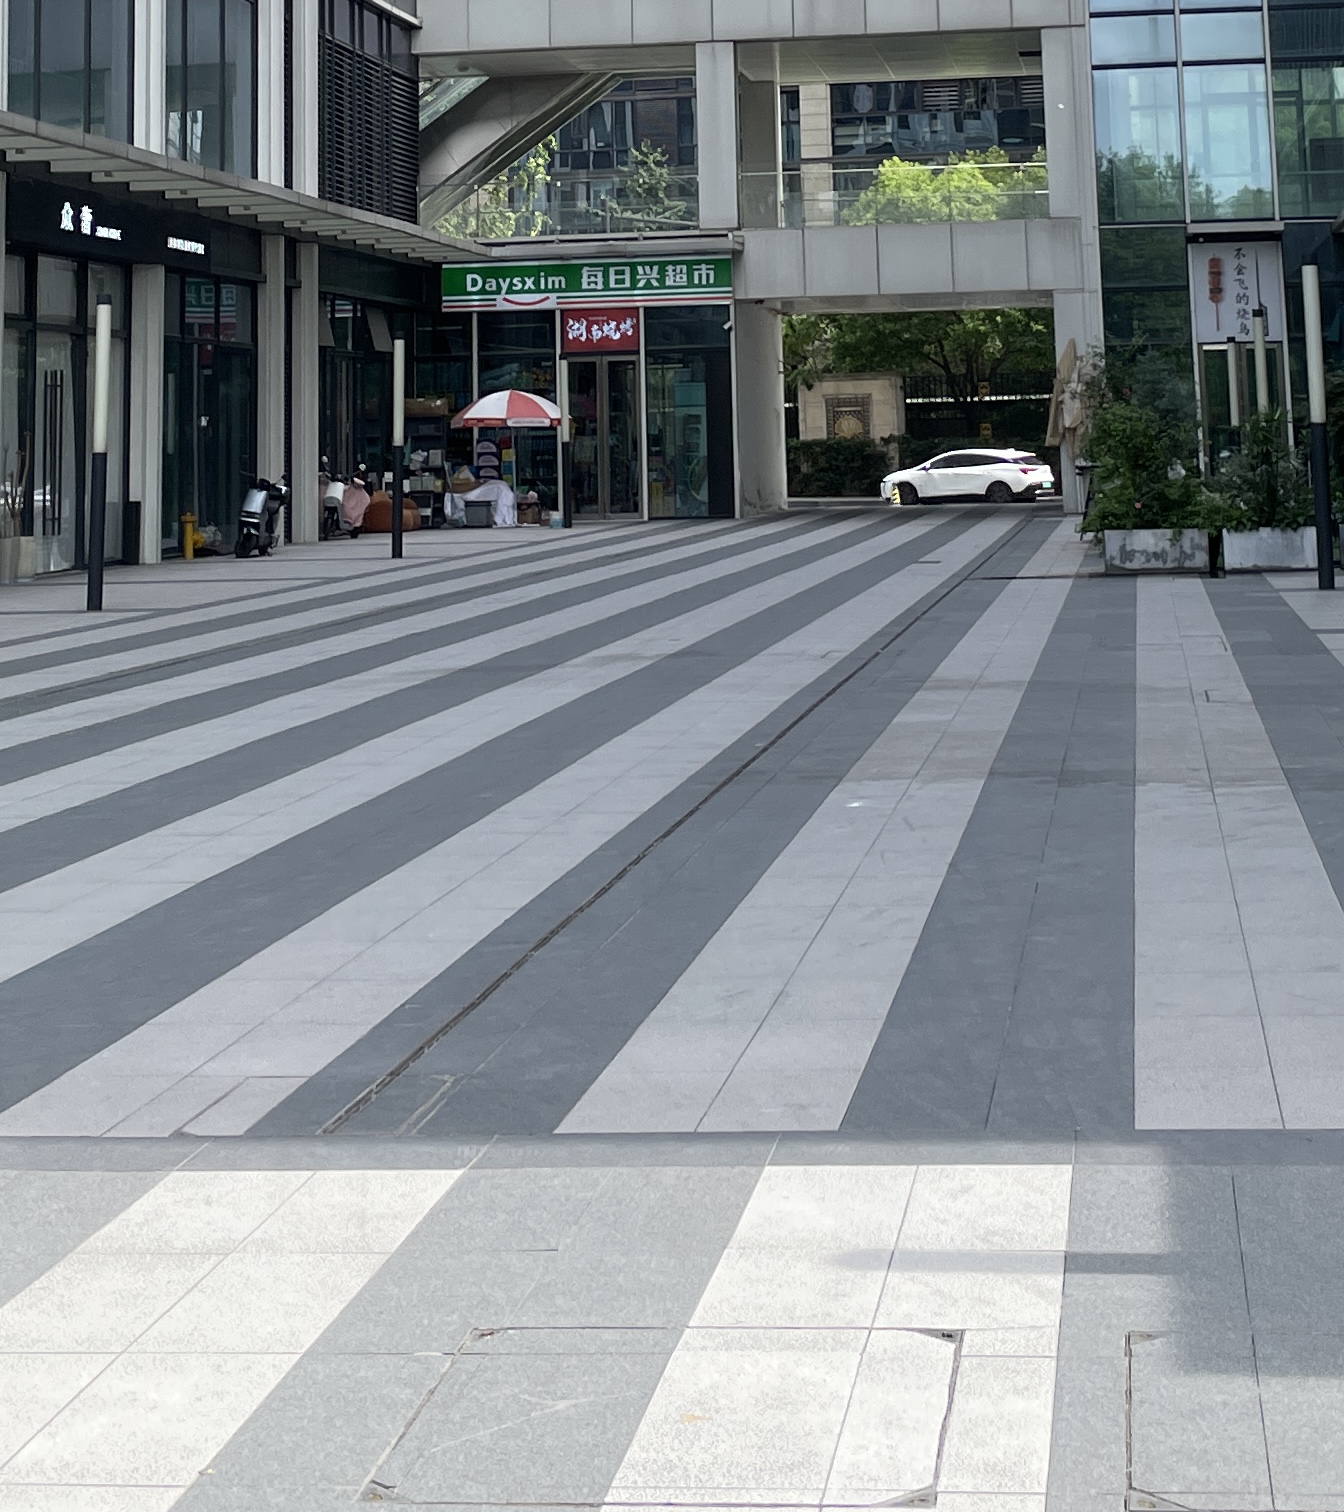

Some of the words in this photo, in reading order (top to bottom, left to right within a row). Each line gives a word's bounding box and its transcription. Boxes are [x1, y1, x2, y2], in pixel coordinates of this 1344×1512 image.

[466, 271, 567, 295] Daysxim
[580, 263, 716, 290] 每日兴超市
